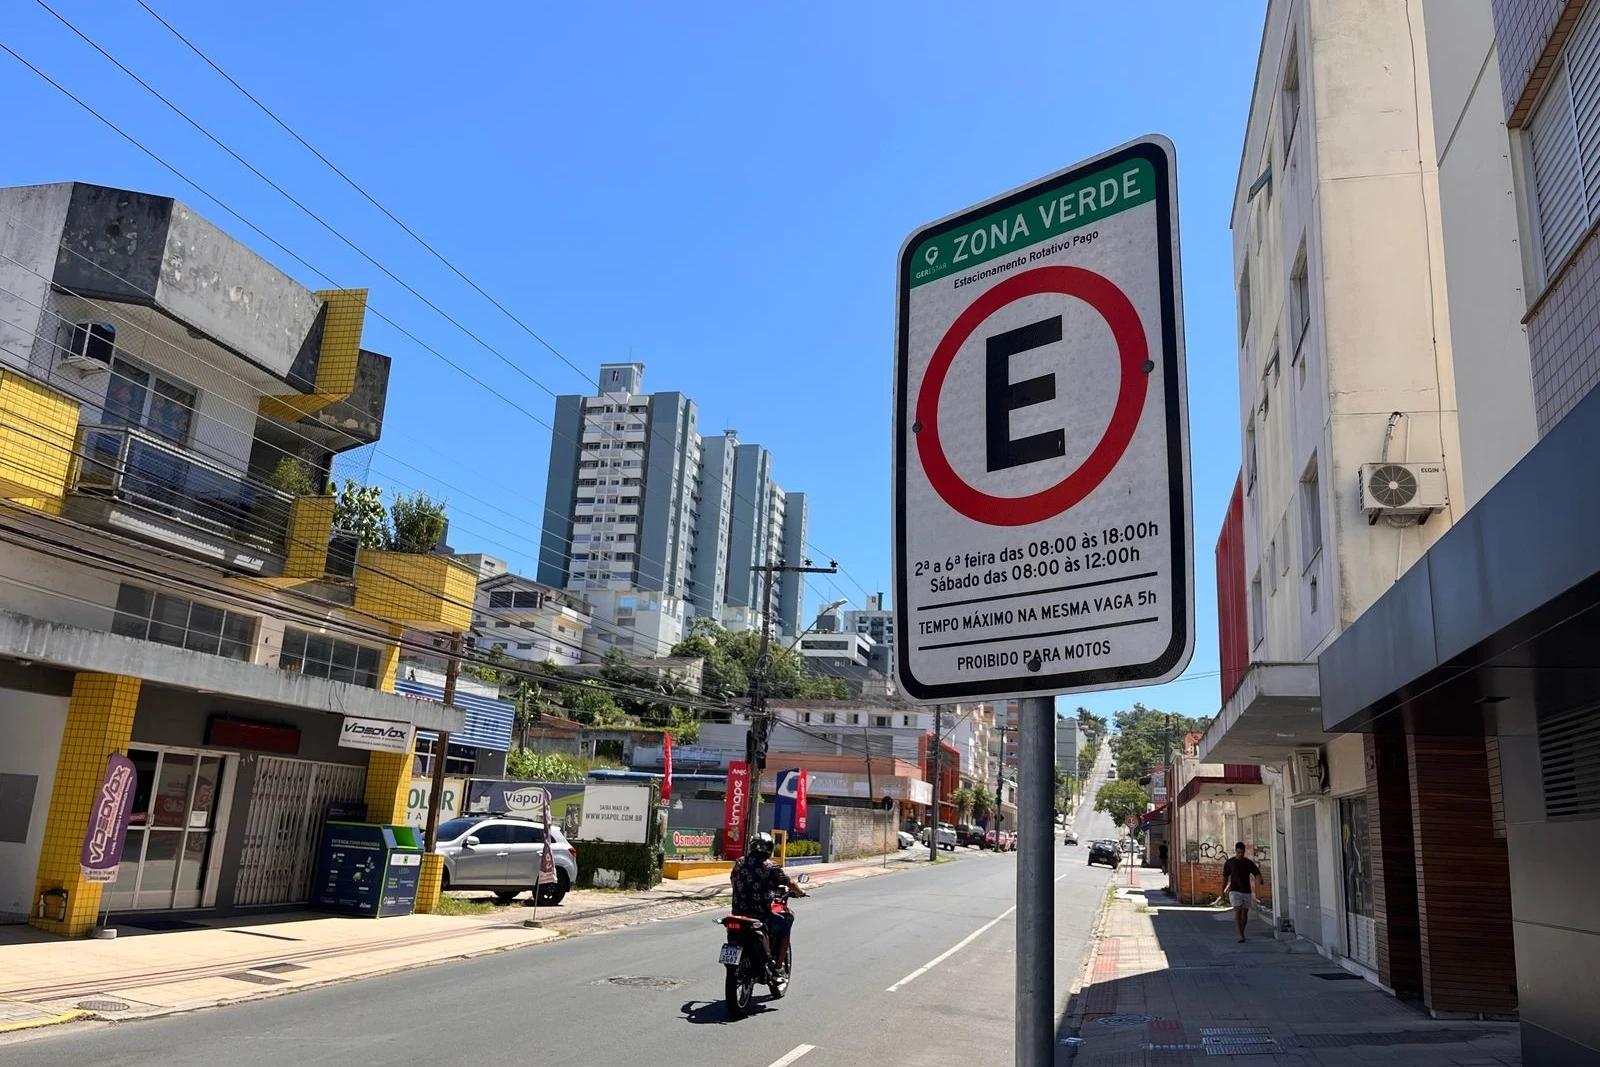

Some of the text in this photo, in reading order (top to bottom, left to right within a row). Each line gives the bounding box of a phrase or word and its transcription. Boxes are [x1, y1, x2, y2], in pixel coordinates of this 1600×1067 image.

[952, 167, 1141, 264] ZONA VERDE
[953, 230, 1099, 289] Estacionamento Rotativo Pago
[986, 314, 1065, 473] E
[915, 521, 1158, 576] 2ª a 6ª feira das 08:00 às 18:00h
[930, 546, 1140, 593] Sábado das 08:00 às 12:00h
[919, 590, 1157, 635] TEMPO MÁXIMO NA MESMA VAGA 5h
[957, 640, 1111, 671] PROIBIDO PARA MOTOS
[407, 788, 455, 810] OLR
[505, 792, 542, 807] Viapol
